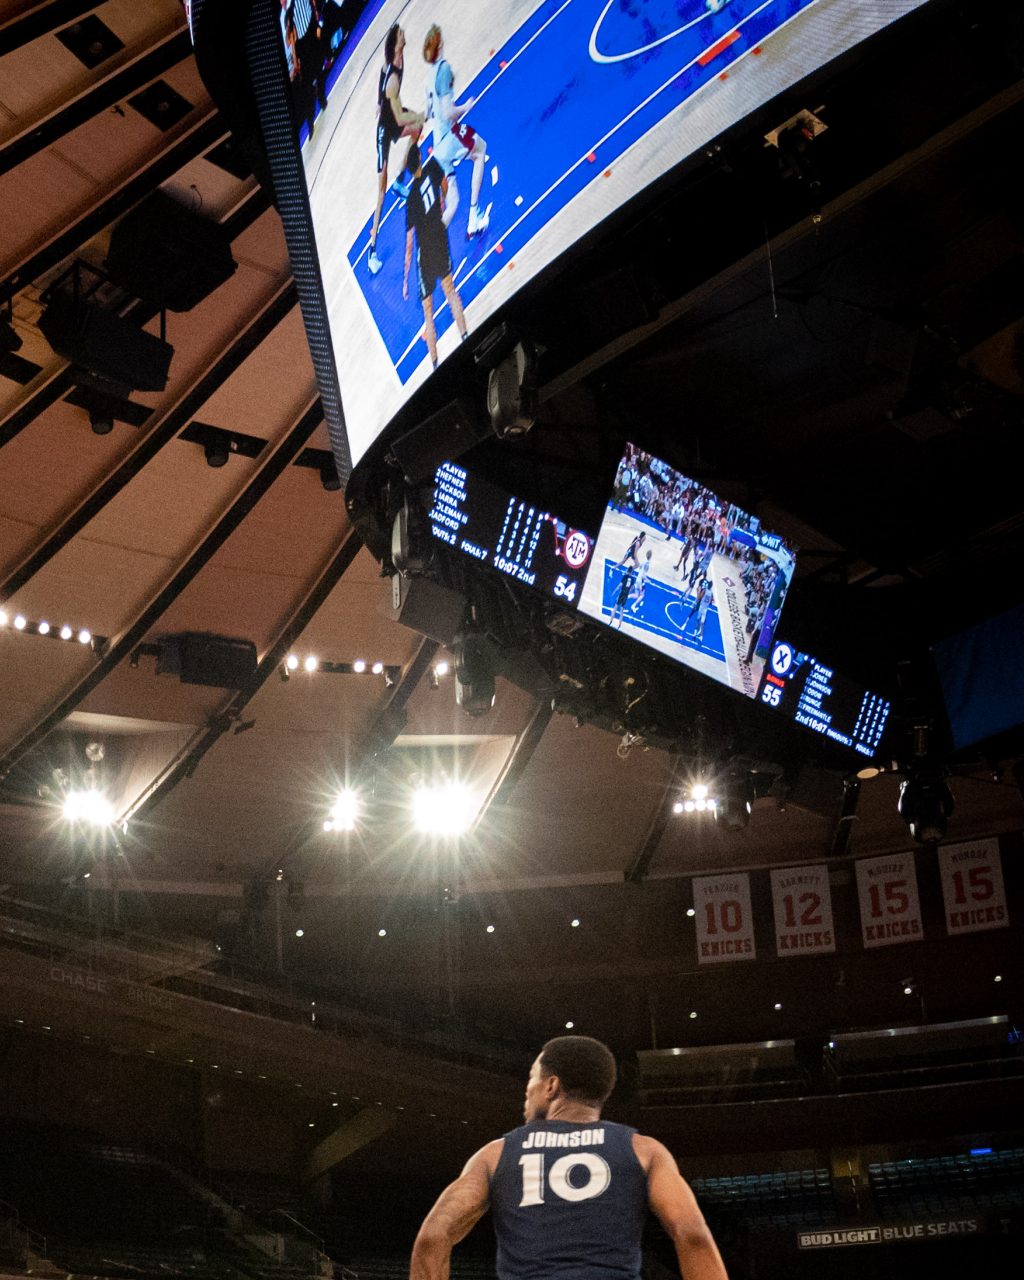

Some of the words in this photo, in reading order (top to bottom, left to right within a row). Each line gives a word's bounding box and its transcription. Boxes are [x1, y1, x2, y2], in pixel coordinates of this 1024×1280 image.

[439, 480, 466, 501] ACKSON
[441, 470, 464, 489] HEFNER
[494, 555, 517, 575] 10:07
[554, 574, 576, 602] 54
[762, 684, 782, 706] 55
[952, 867, 994, 904] 15
[783, 892, 822, 928] 12
[868, 880, 909, 918] 15
[705, 900, 742, 935] 10
[950, 905, 1005, 927] KNICKS
[780, 931, 832, 949] KNICKS
[866, 919, 919, 941] KNICKS
[701, 939, 752, 957] KNICKS
[522, 1129, 605, 1149] JOHNSON
[518, 1152, 612, 1207] 10
[801, 1234, 832, 1247] BUD
[834, 1229, 877, 1244] LIGHT
[883, 1225, 924, 1240] BLUE
[927, 1219, 977, 1237] SEATS
